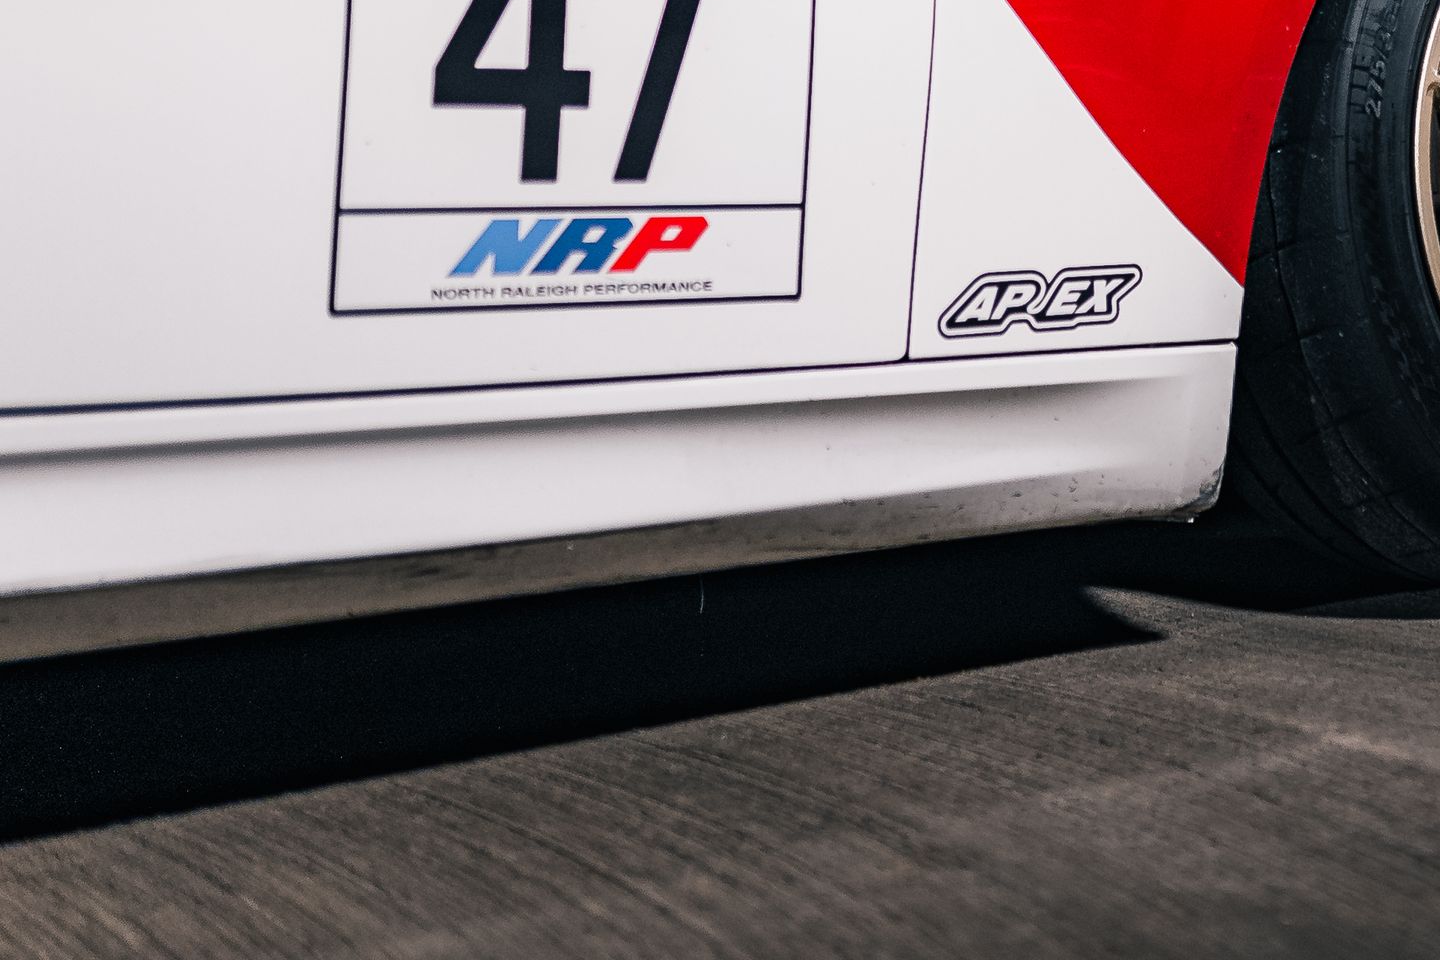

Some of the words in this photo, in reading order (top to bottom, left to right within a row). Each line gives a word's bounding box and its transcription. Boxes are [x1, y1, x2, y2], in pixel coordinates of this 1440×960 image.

[448, 216, 709, 278] NRP
[431, 286, 495, 302] NORTH
[499, 283, 577, 299] RALEIGH
[583, 280, 714, 296] PERFORMANCE
[944, 271, 1136, 331] APEX
